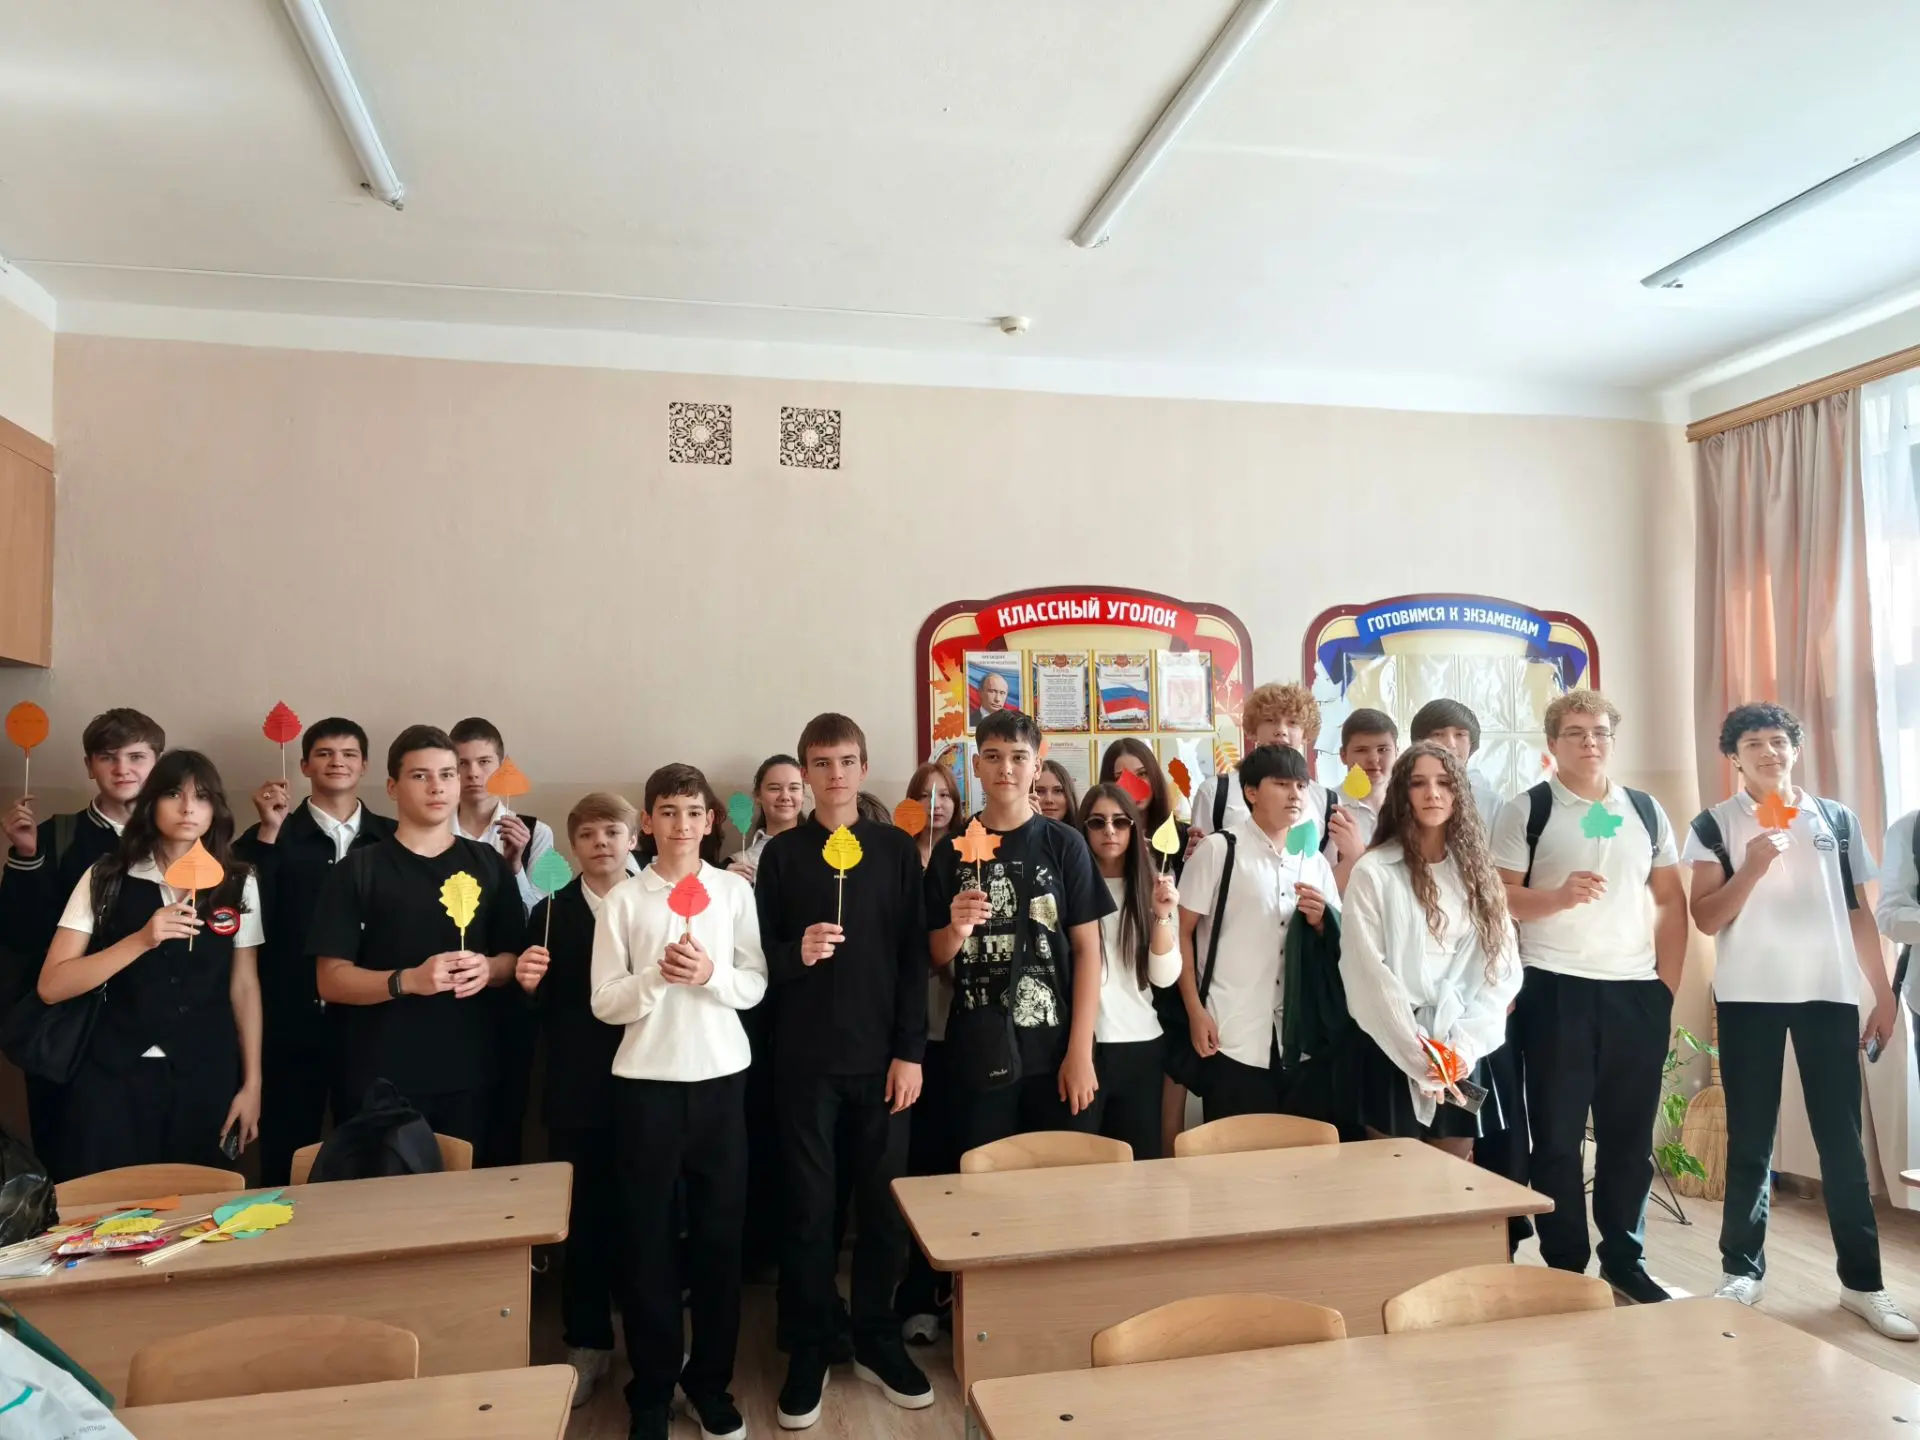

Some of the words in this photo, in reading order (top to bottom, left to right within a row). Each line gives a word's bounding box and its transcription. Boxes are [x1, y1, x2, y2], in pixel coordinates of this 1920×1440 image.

[997, 597, 1100, 628] КЛАССНЫЙ
[1107, 600, 1178, 628] УГОЛОК
[1367, 606, 1445, 632] ГОТОВИМСЯ
[1450, 607, 1459, 621] К
[1463, 607, 1539, 637] ЭКЗАМЕНАМ
[1039, 940, 1049, 953] 5
